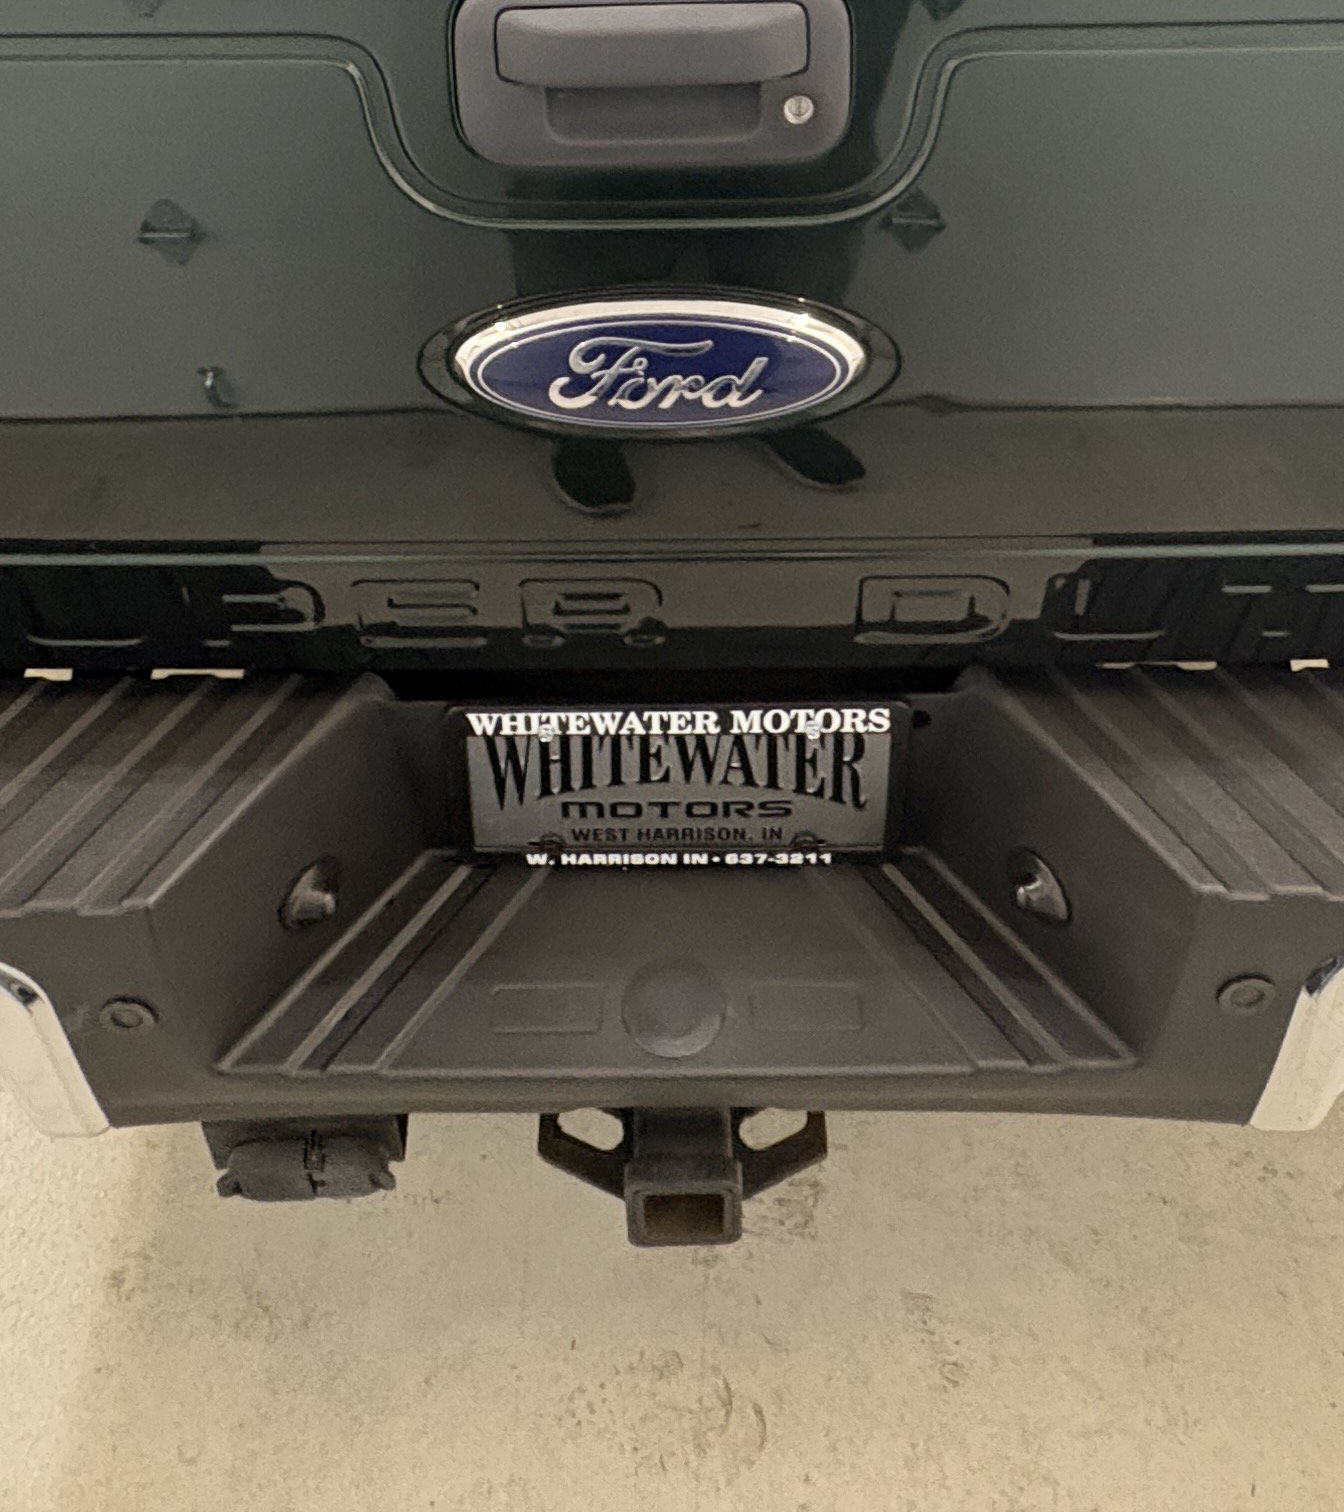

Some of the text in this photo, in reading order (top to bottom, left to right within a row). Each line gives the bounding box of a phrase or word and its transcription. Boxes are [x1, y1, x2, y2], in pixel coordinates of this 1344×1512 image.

[548, 337, 769, 410] Ford
[465, 708, 892, 738] WHITEWATER MOTORS
[485, 733, 869, 813] WHITEWATER
[560, 800, 794, 820] MOTORS
[571, 827, 630, 842] WEST
[761, 827, 783, 841] IN
[526, 851, 833, 866] W. HARRISON IN 637-3211
